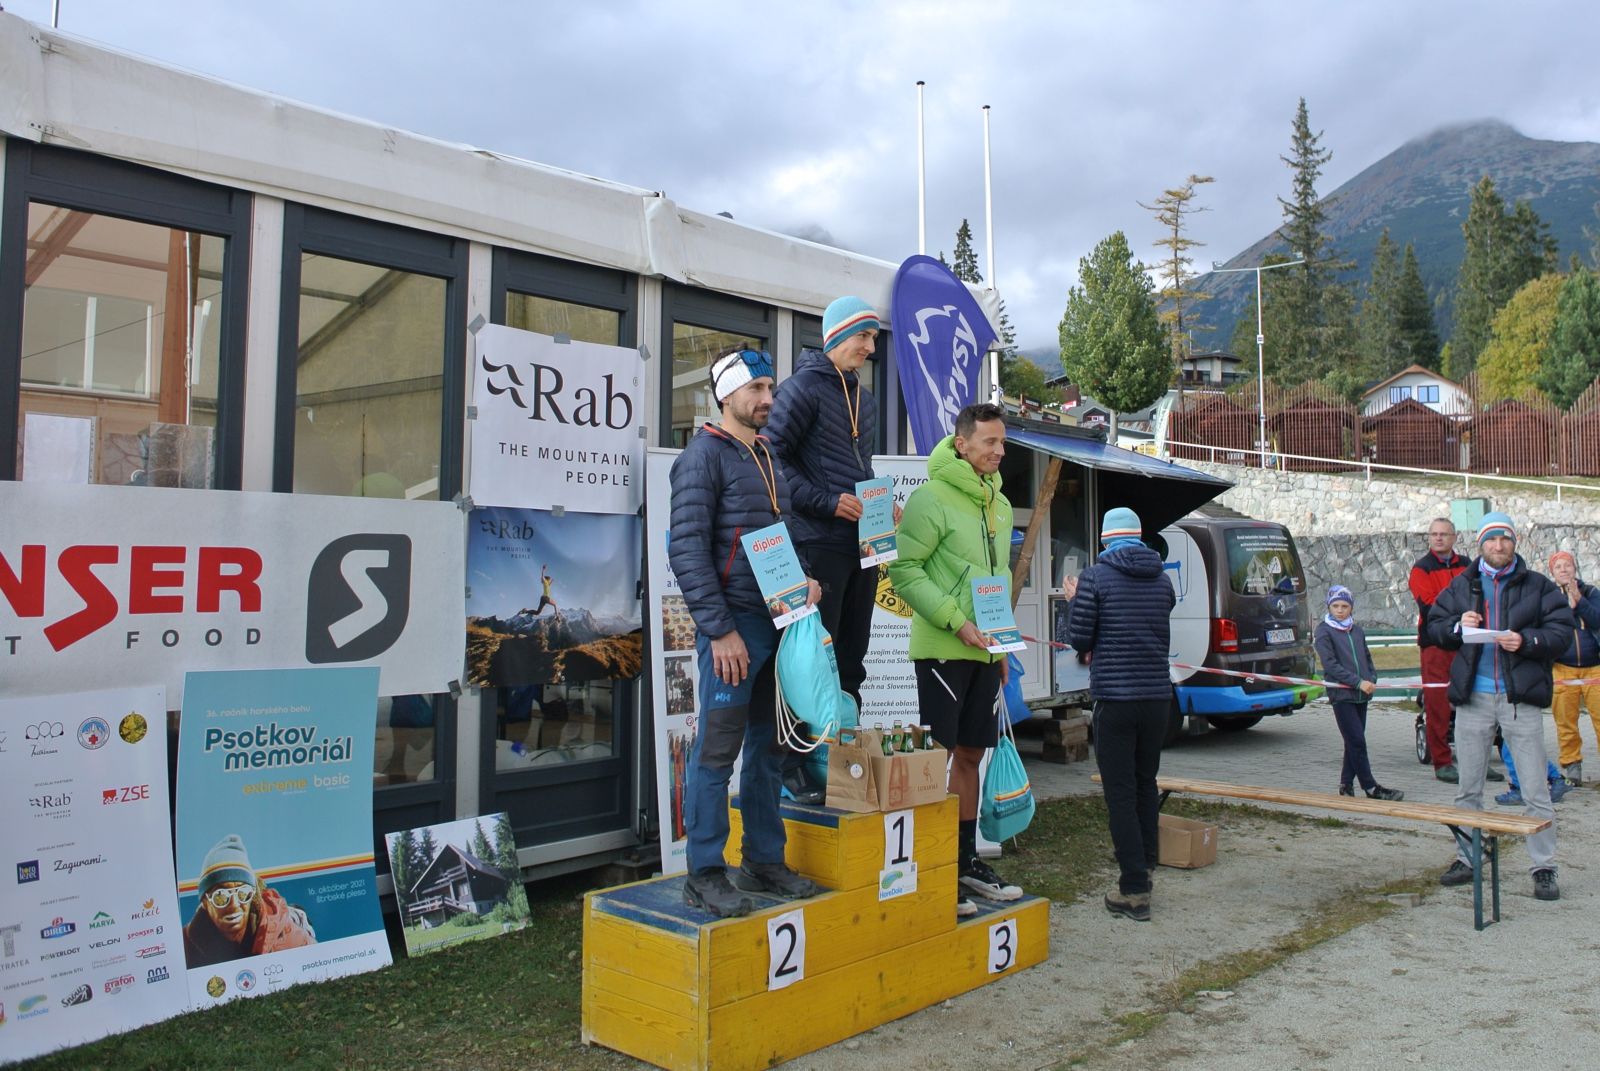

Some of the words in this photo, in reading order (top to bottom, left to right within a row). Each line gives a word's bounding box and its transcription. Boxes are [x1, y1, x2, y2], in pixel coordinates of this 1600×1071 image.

[528, 362, 633, 430] Rab
[499, 441, 529, 458] THE
[538, 446, 631, 467] MOUNTAIN
[566, 470, 630, 487] PEOPLE
[862, 485, 888, 500] diplom
[498, 519, 534, 541] Rab
[752, 535, 784, 553] diplom
[977, 583, 1003, 596] diplom
[873, 623, 909, 631] horolezcov,
[126, 628, 261, 650] FOOD
[204, 722, 317, 752] Psotkov
[224, 736, 352, 771] memoriál
[243, 779, 308, 795] extreme
[313, 772, 351, 788] basic
[43, 793, 71, 809] Rab
[120, 784, 150, 803] ZSE
[891, 815, 909, 865] 1
[54, 854, 102, 874] Zagurami
[132, 906, 161, 920] mixit
[43, 924, 73, 938] BIRELL
[89, 938, 121, 949] VELON
[774, 922, 798, 978] 2
[994, 925, 1012, 971] 3
[40, 946, 81, 961] POWERLOGY
[104, 975, 135, 993] grafon
